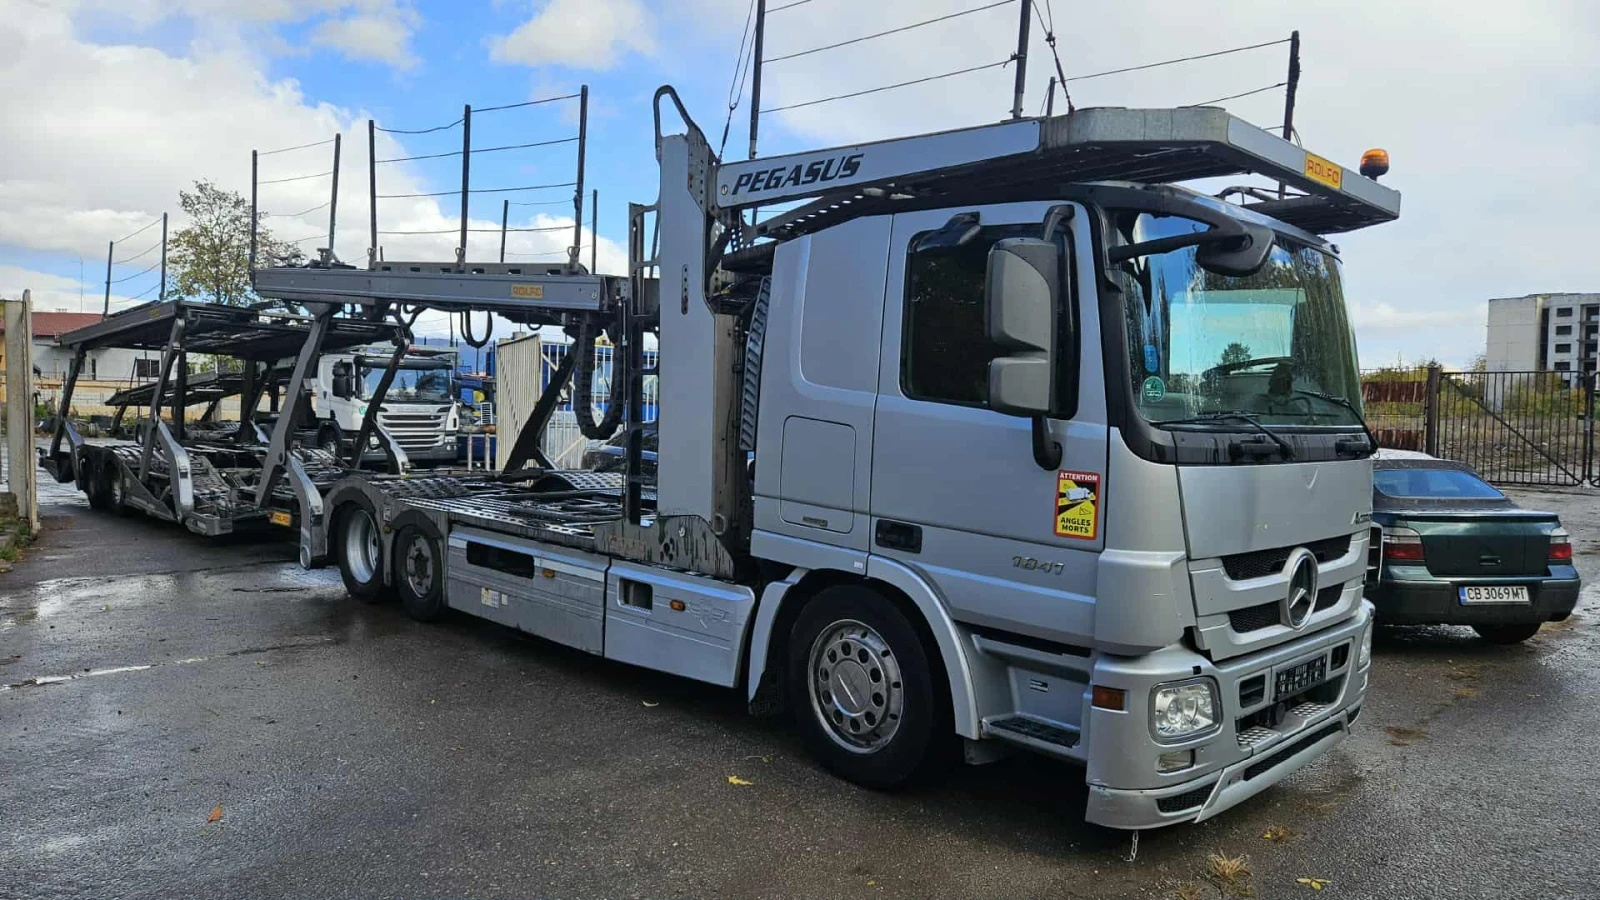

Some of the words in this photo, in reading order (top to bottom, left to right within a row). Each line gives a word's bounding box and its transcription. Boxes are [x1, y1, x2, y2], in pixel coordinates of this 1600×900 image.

[731, 153, 865, 195] PEGASUS
[1306, 158, 1340, 184] ROLFO
[1059, 472, 1098, 481] ATTENTION
[1060, 517, 1091, 527] ANGLES
[1061, 524, 1089, 534] MORTS
[1467, 587, 1482, 600] CB
[1484, 587, 1510, 600] 3069
[1511, 587, 1525, 600] MT
